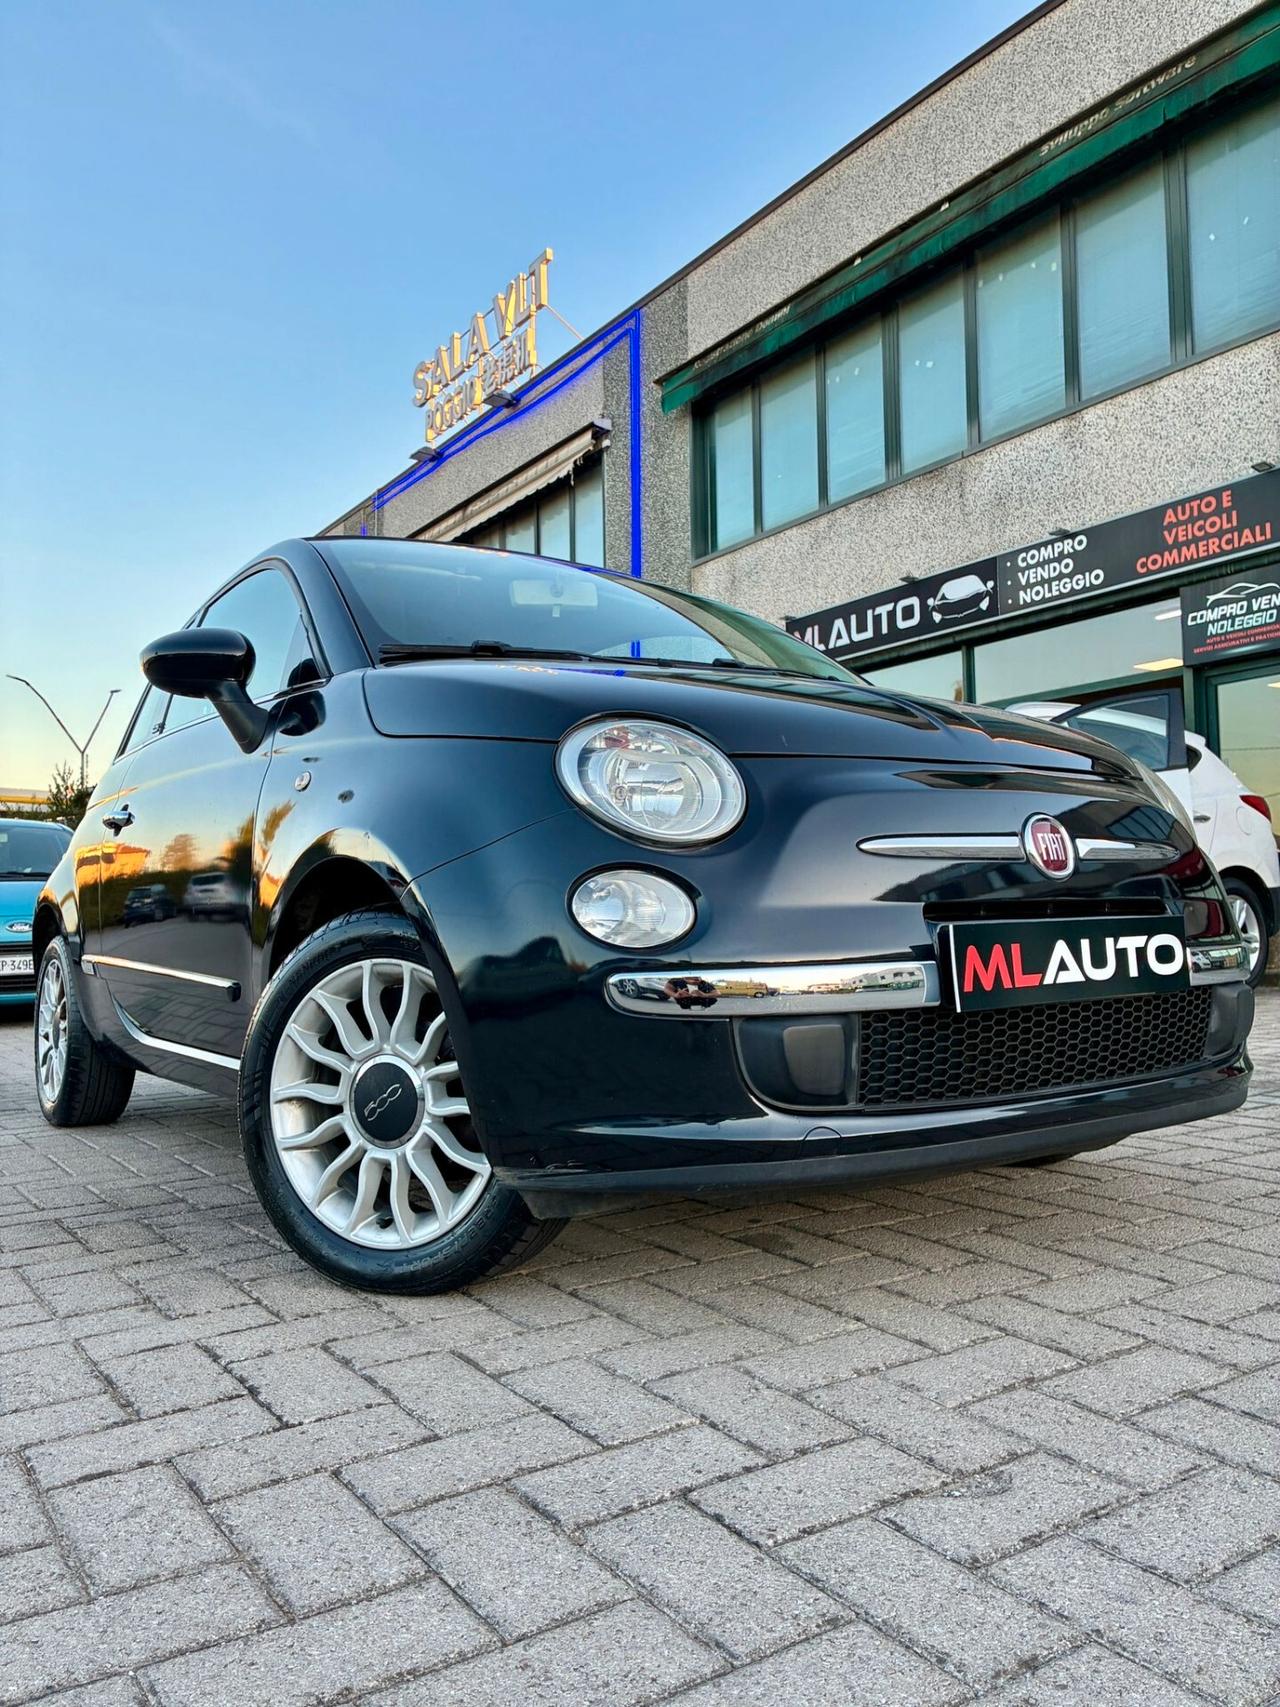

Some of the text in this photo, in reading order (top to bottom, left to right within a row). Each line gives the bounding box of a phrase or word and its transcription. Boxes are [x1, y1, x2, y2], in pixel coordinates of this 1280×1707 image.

[413, 312, 490, 407] SALA
[1163, 490, 1232, 526] AUTO E
[1163, 510, 1238, 546] VEICOLI
[1017, 534, 1088, 568] COMPRO
[1136, 522, 1272, 574] COMMERCIALI
[1018, 558, 1074, 586] VENDO
[1018, 569, 1105, 605] NOLEGGIO
[1187, 592, 1280, 626] COMPRO VEN
[1207, 609, 1278, 636] NOLEGGIO
[1036, 832, 1066, 861] FIAT
[963, 933, 1184, 993] MLAUTO
